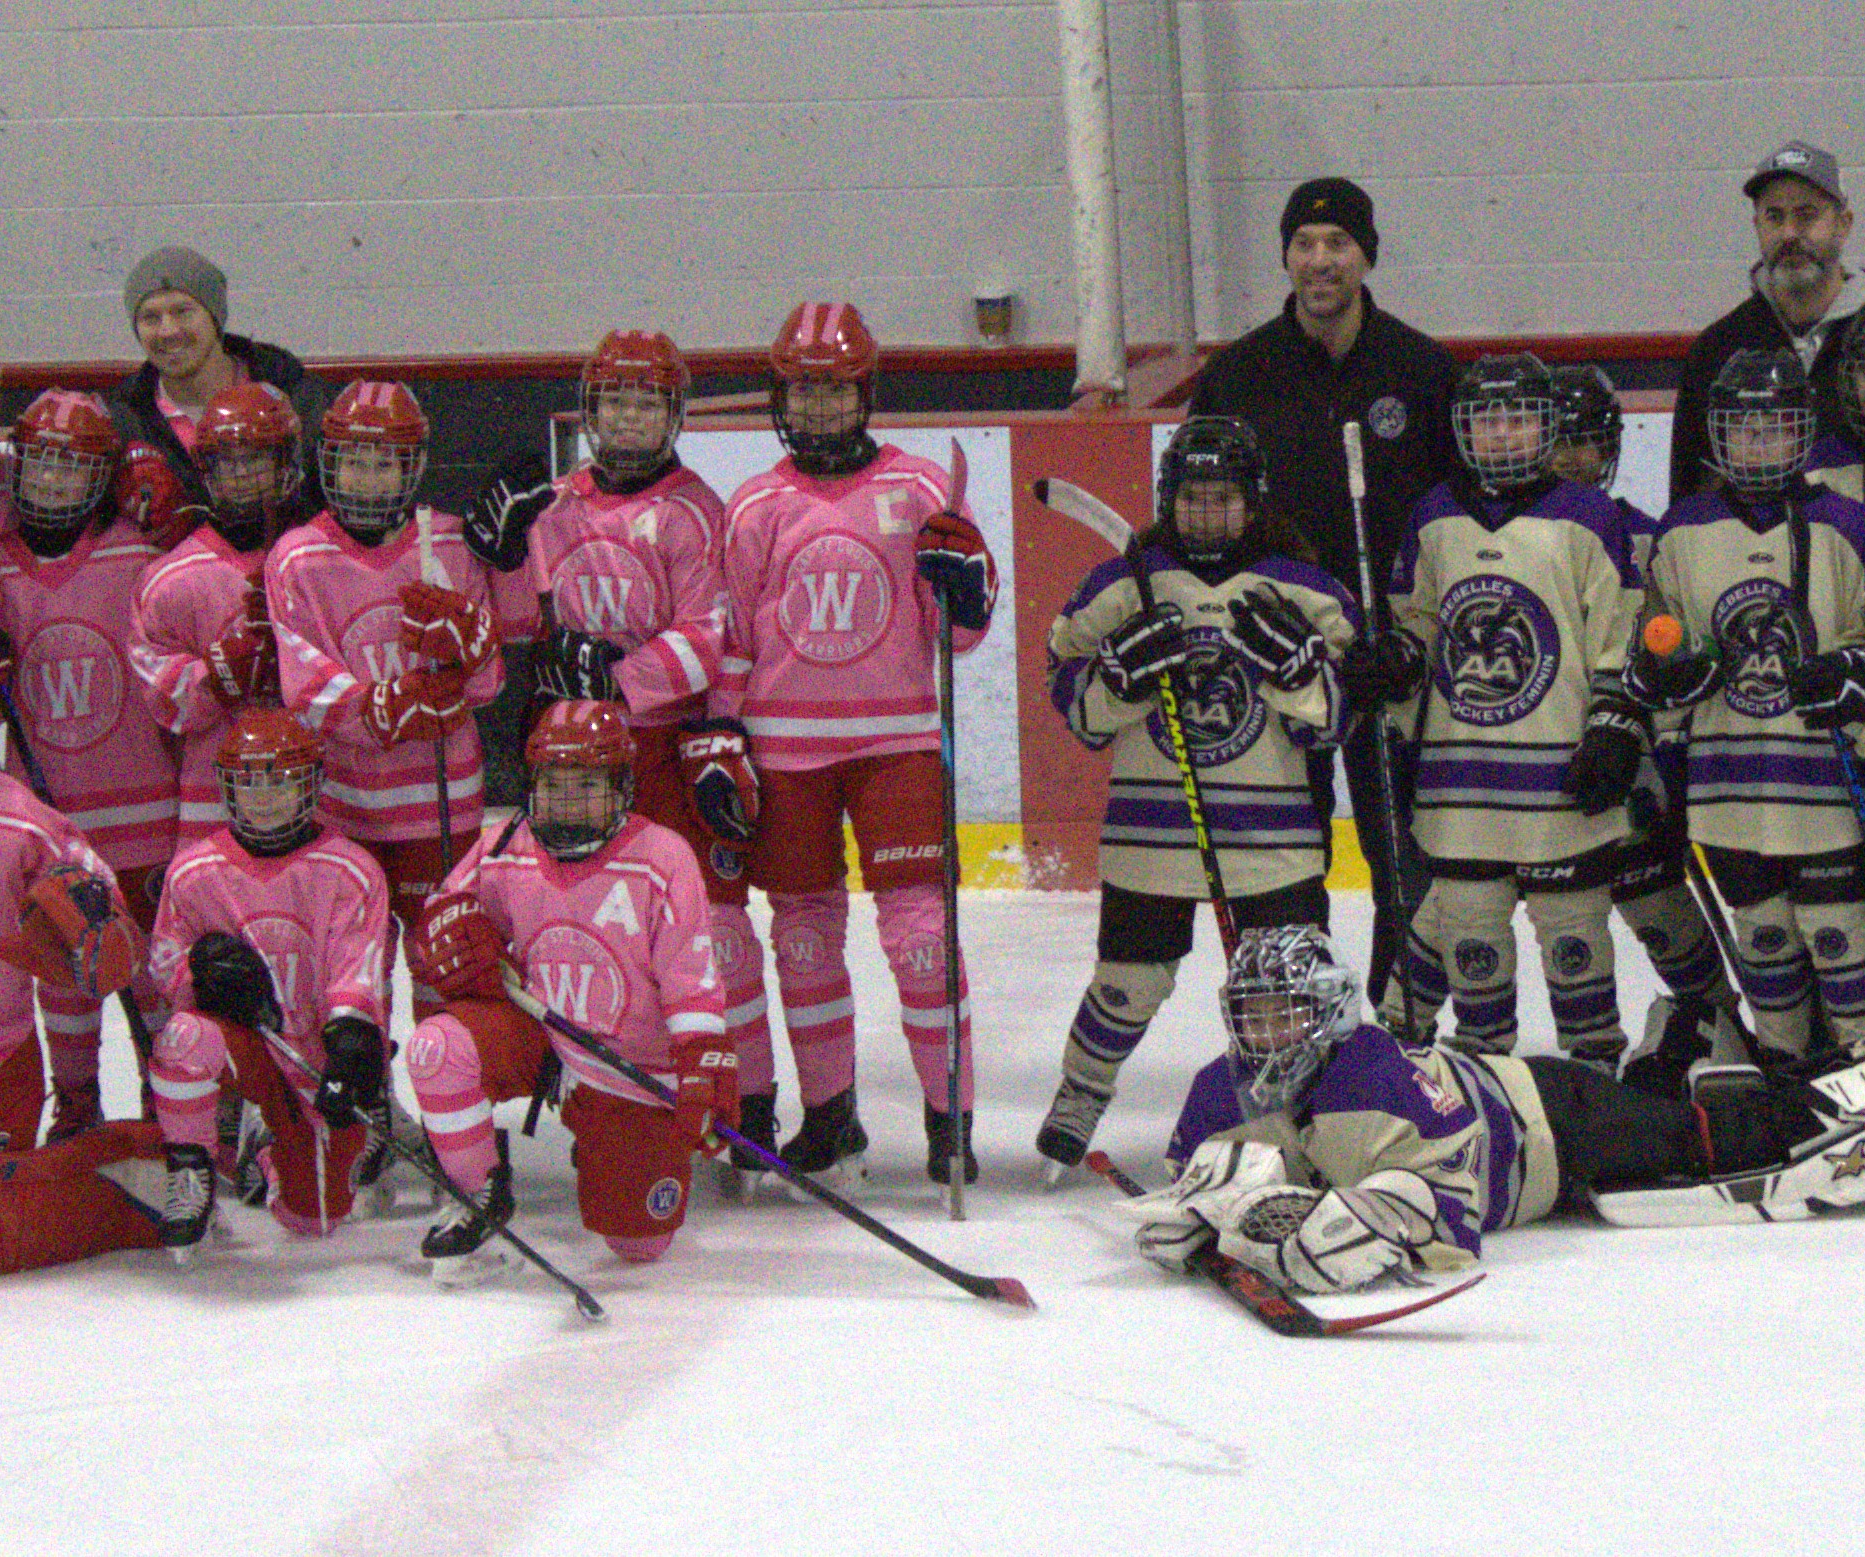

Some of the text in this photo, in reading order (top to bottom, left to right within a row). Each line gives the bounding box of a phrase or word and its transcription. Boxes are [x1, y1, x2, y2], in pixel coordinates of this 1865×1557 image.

[630, 508, 657, 546] A
[577, 575, 633, 632] W
[802, 572, 862, 632] W
[1438, 578, 1515, 623] REBELLES
[41, 656, 95, 719] W
[1457, 656, 1520, 683] AA
[1508, 652, 1555, 717] FEMININ
[1738, 653, 1783, 678] AA
[1515, 864, 1577, 879] CCM
[592, 879, 640, 935] A
[909, 947, 933, 972] W
[538, 962, 594, 1023] W
[410, 1038, 435, 1066] W
